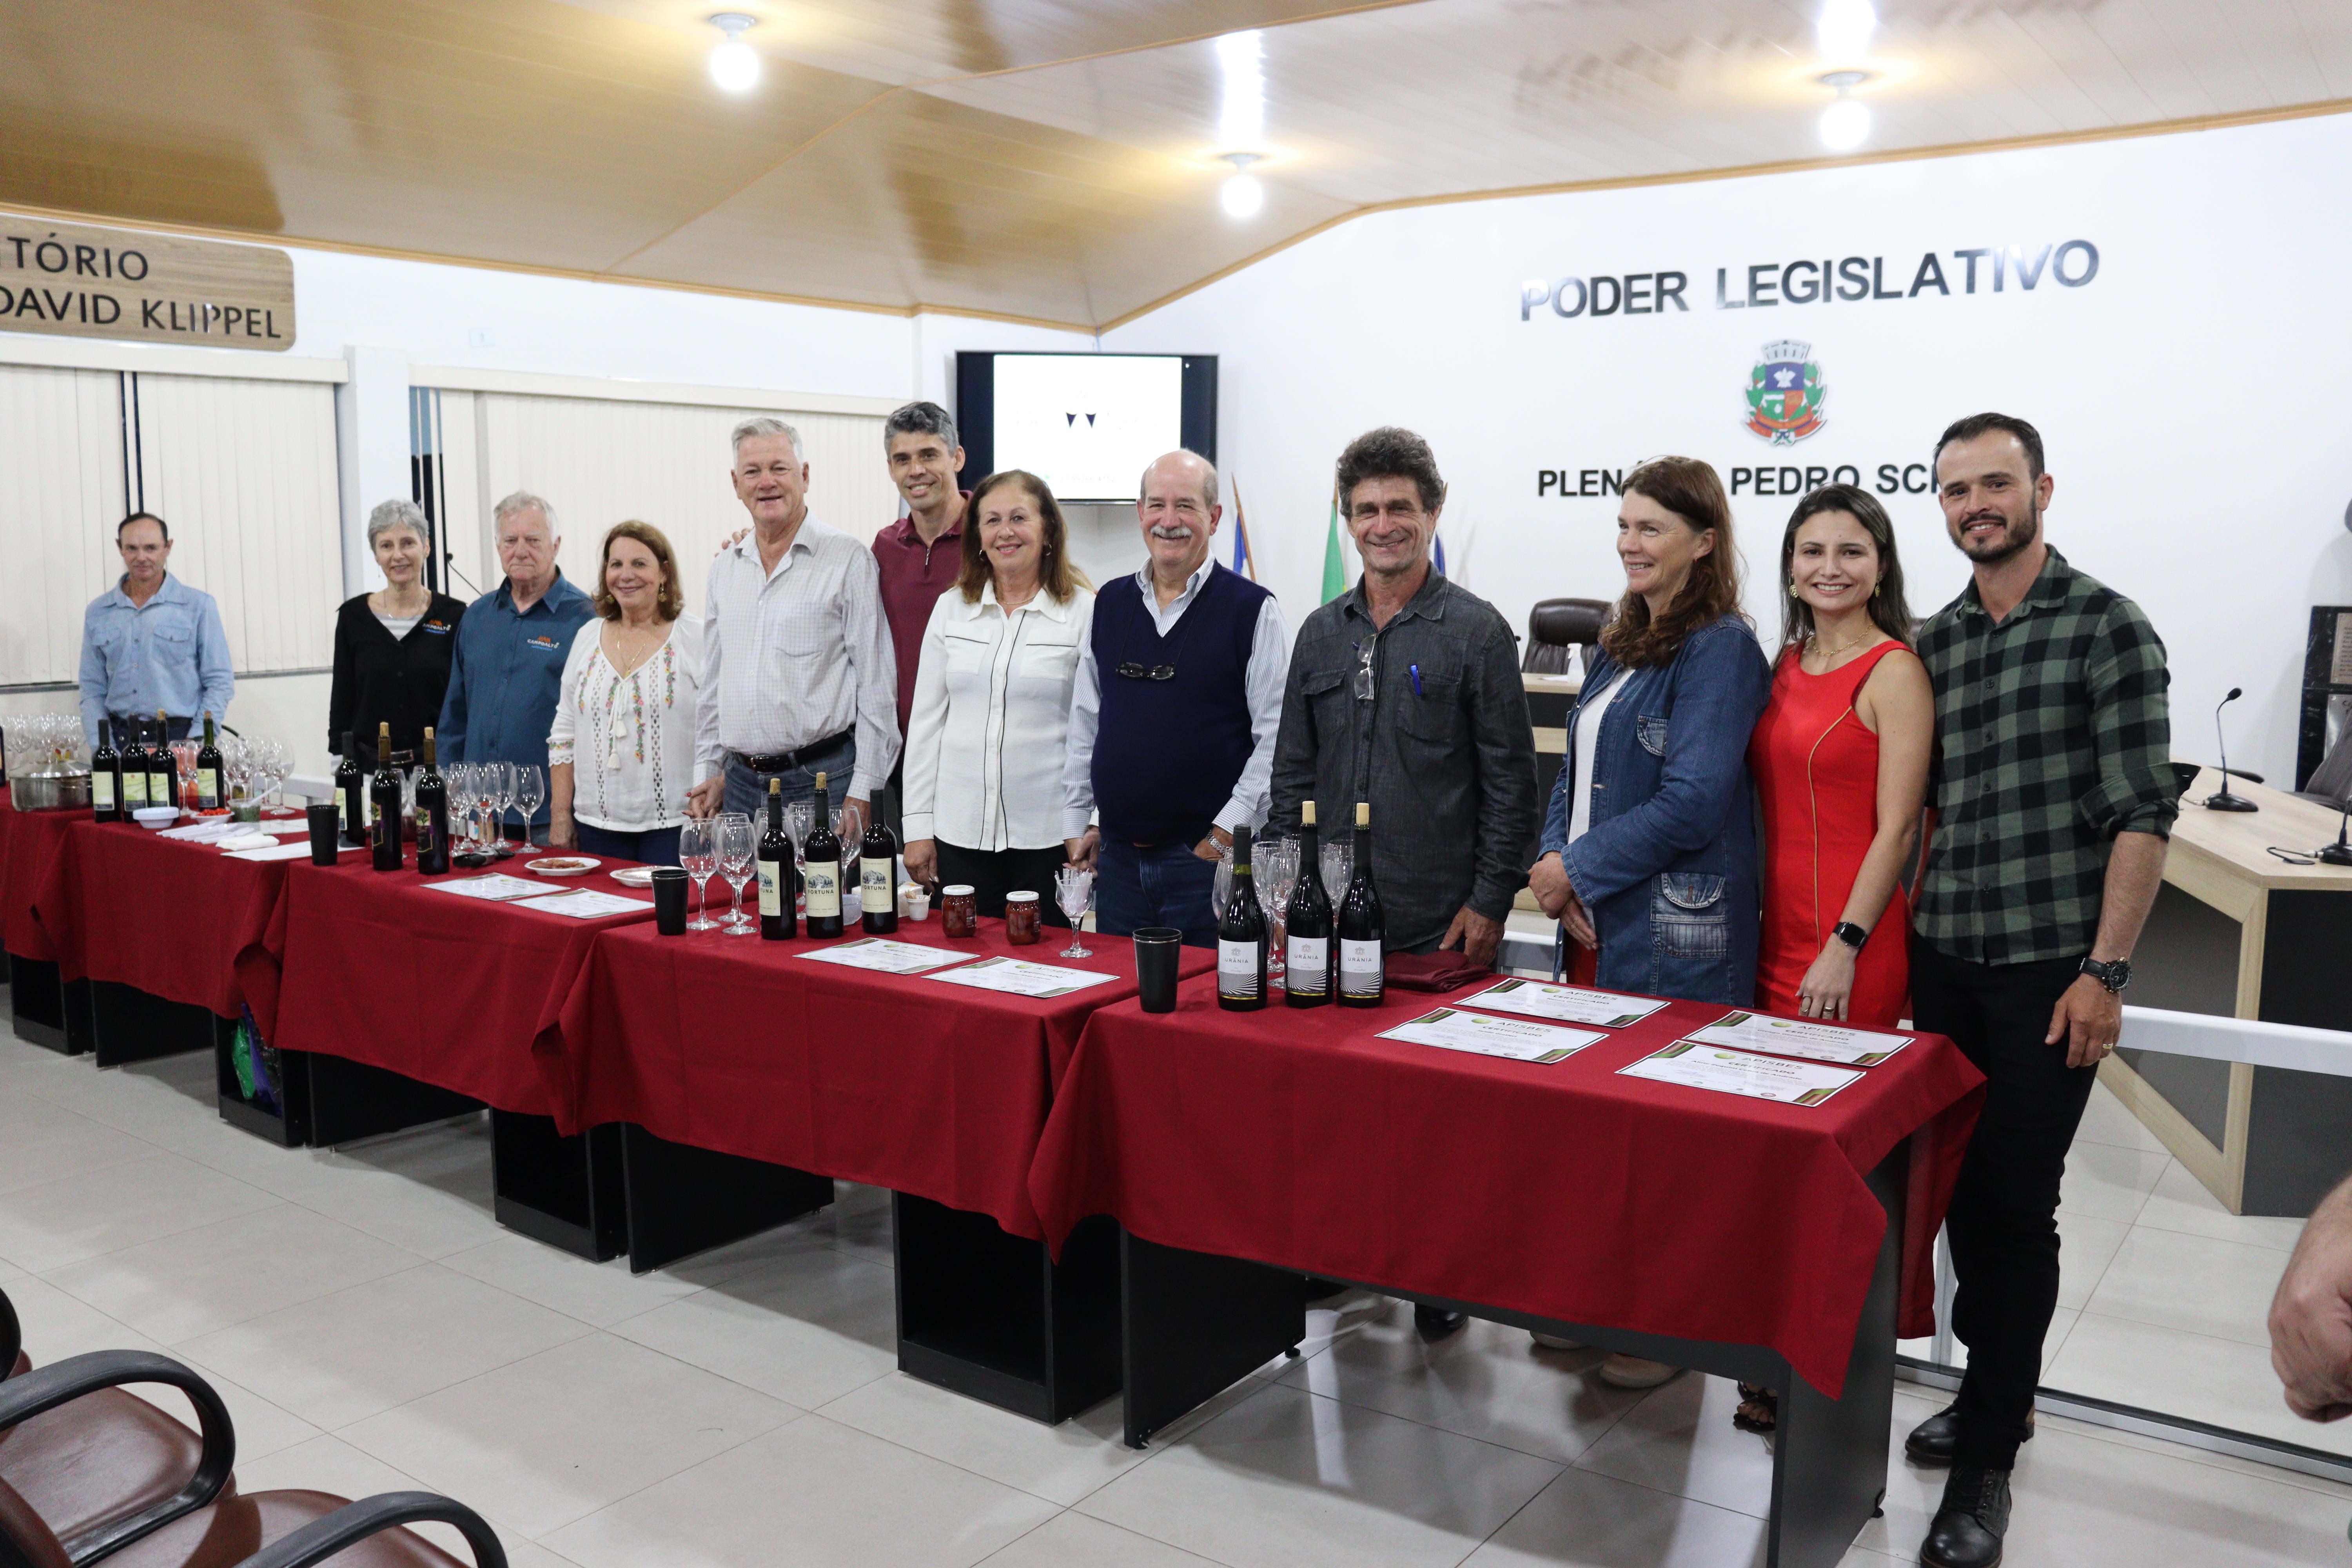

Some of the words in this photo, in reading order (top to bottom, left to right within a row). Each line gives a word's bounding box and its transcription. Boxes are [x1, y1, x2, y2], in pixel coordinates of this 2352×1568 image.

[1521, 270, 1690, 321] PODER
[1716, 239, 2100, 310] LEGISLATIVO
[142, 298, 281, 338] KLIPPEL
[1538, 469, 1623, 497] PLEN
[1731, 464, 1860, 495] PEDRO
[1553, 995, 1610, 1005] CERTIFICADO
[1566, 991, 1618, 1001] APISBES
[1482, 1026, 1543, 1037] CERTIFICADO
[1497, 1021, 1552, 1033] APISBES
[1798, 1025, 1856, 1036] APISBES
[1785, 1029, 1849, 1041] CERTIFICADO
[1728, 1062, 1795, 1074] CERTIFICADO
[1742, 1057, 1804, 1069] APISBES
